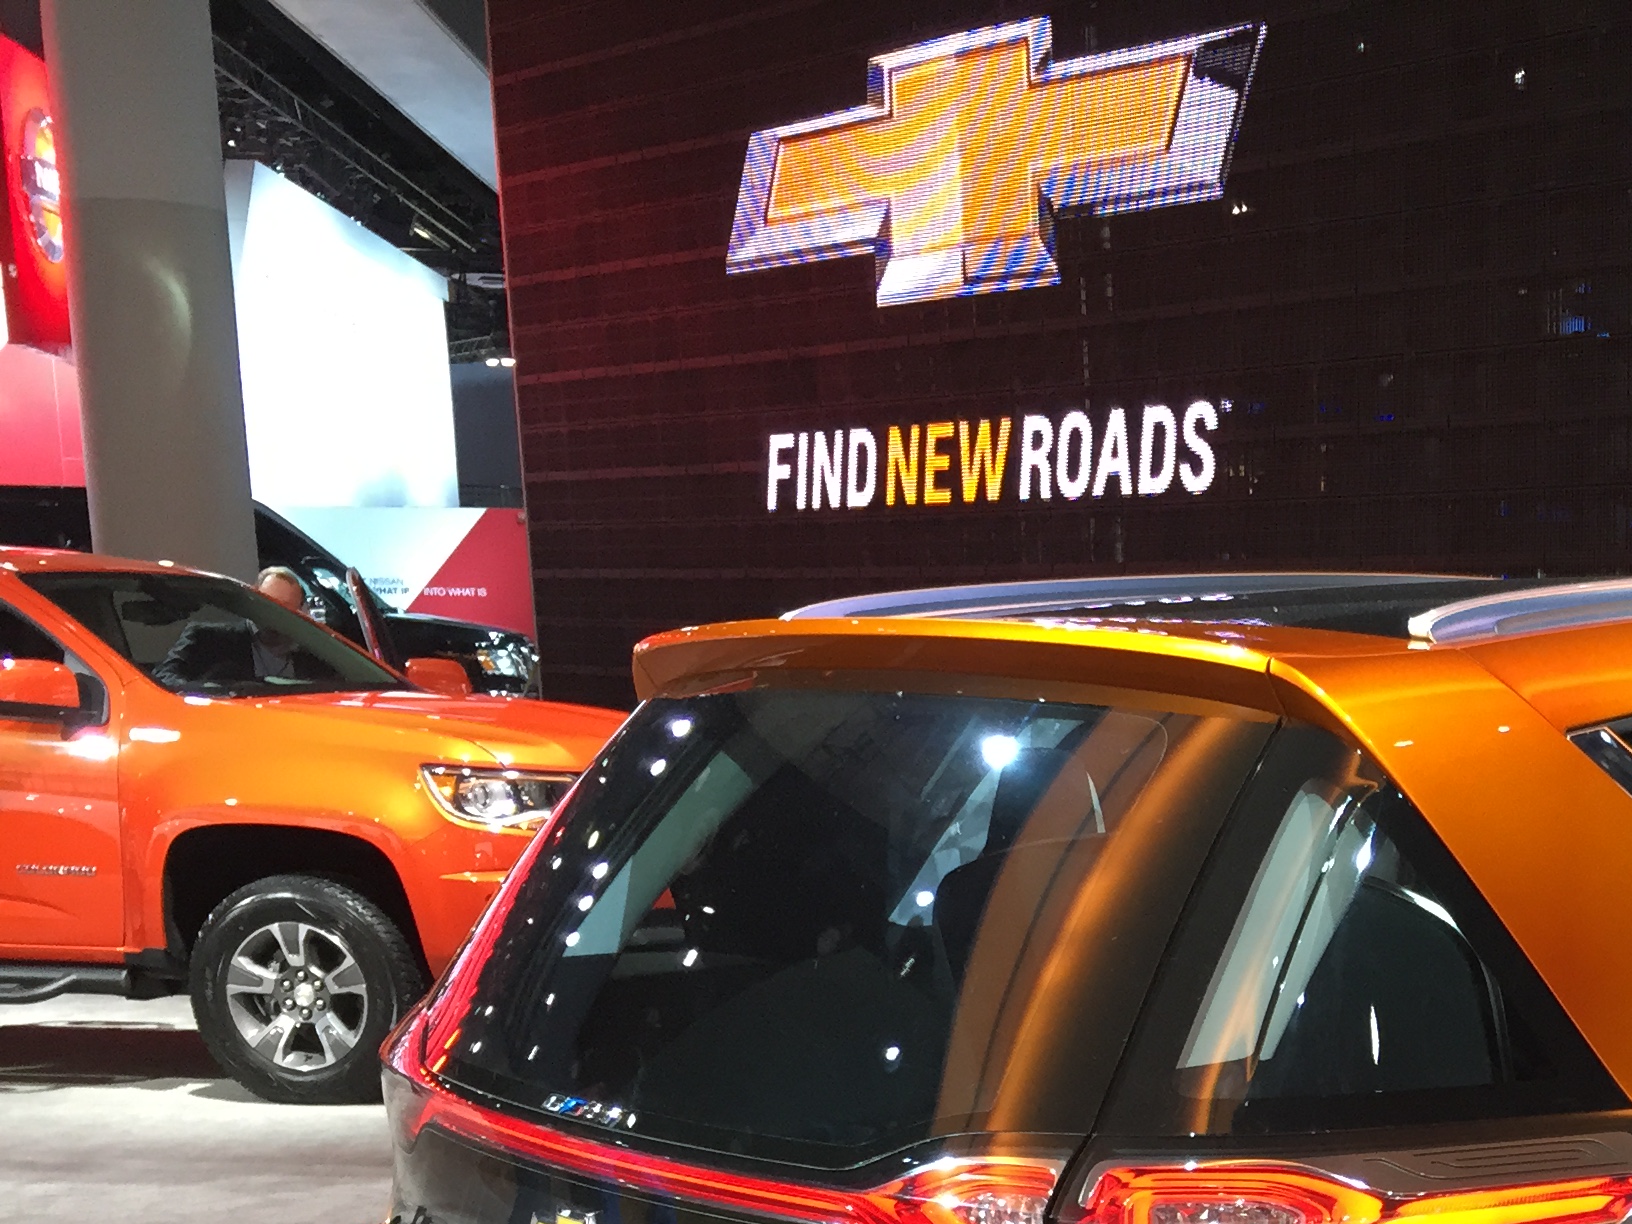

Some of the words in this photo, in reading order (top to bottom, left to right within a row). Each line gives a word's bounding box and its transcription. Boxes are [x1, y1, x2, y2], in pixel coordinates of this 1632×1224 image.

[766, 427, 877, 512] FIND
[885, 417, 1012, 507] NEW
[1019, 400, 1219, 502] ROADS
[423, 586, 447, 597] INTO
[447, 586, 476, 597] WHAT
